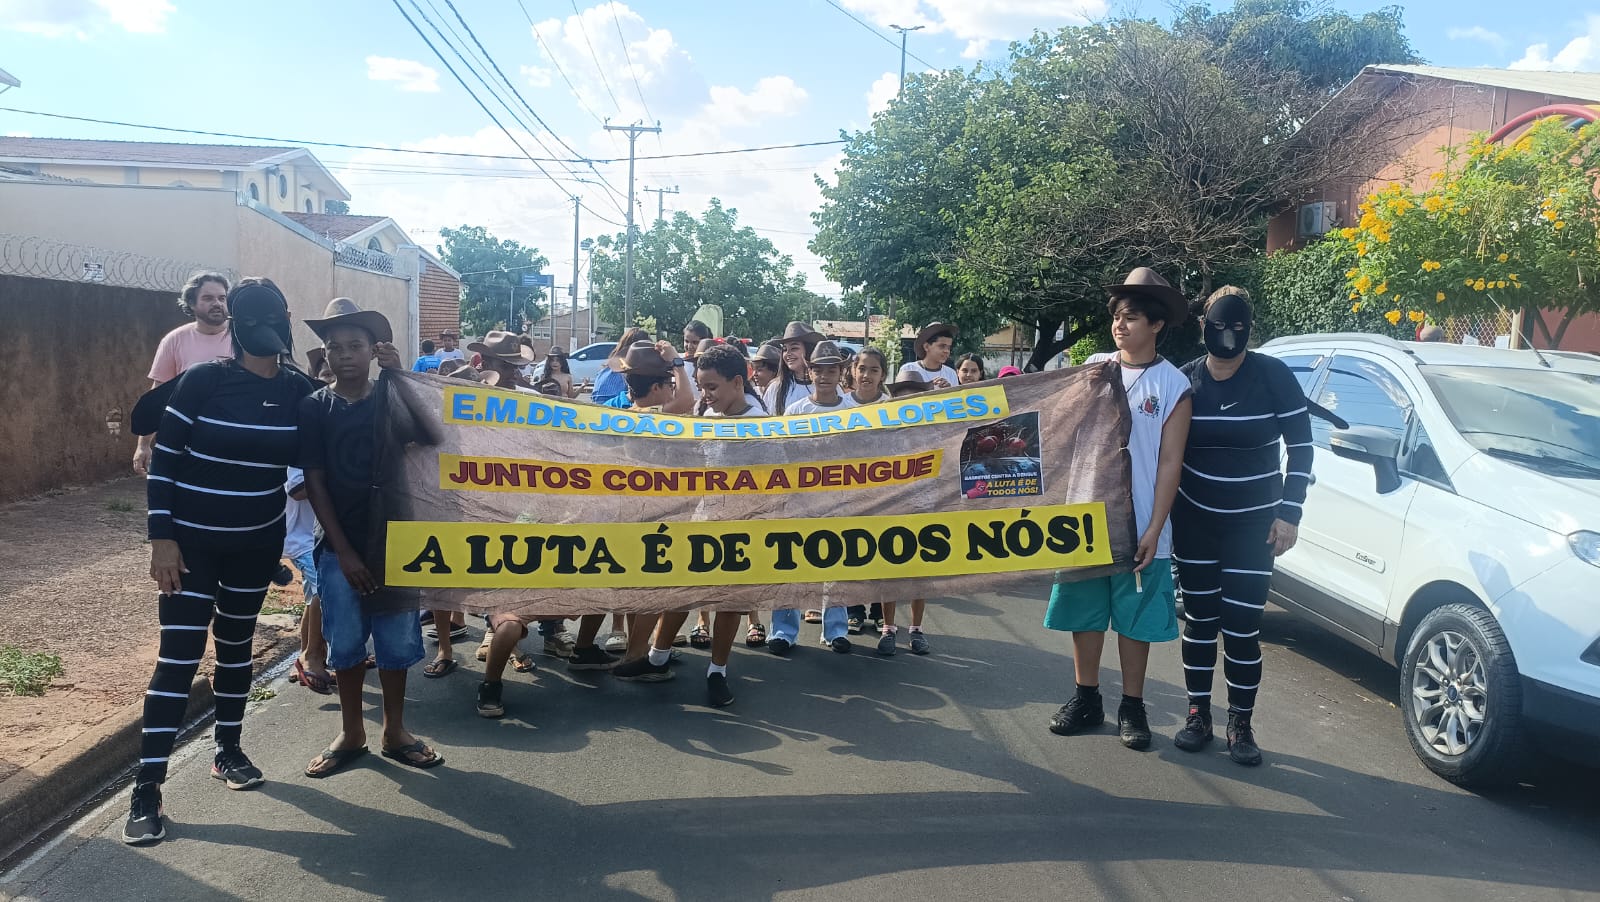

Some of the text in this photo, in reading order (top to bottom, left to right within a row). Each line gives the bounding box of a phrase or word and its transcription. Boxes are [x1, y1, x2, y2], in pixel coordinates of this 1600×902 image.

[694, 412, 872, 438] FERREIRA
[879, 394, 1000, 427] LOPES.
[449, 455, 935, 491] JUNTOS CONTRA A DENGUE
[988, 486, 1038, 496] TODOS NÓS!
[1018, 478, 1024, 486] É
[403, 508, 1094, 574] A LUTA É DE TODOS NÓS!
